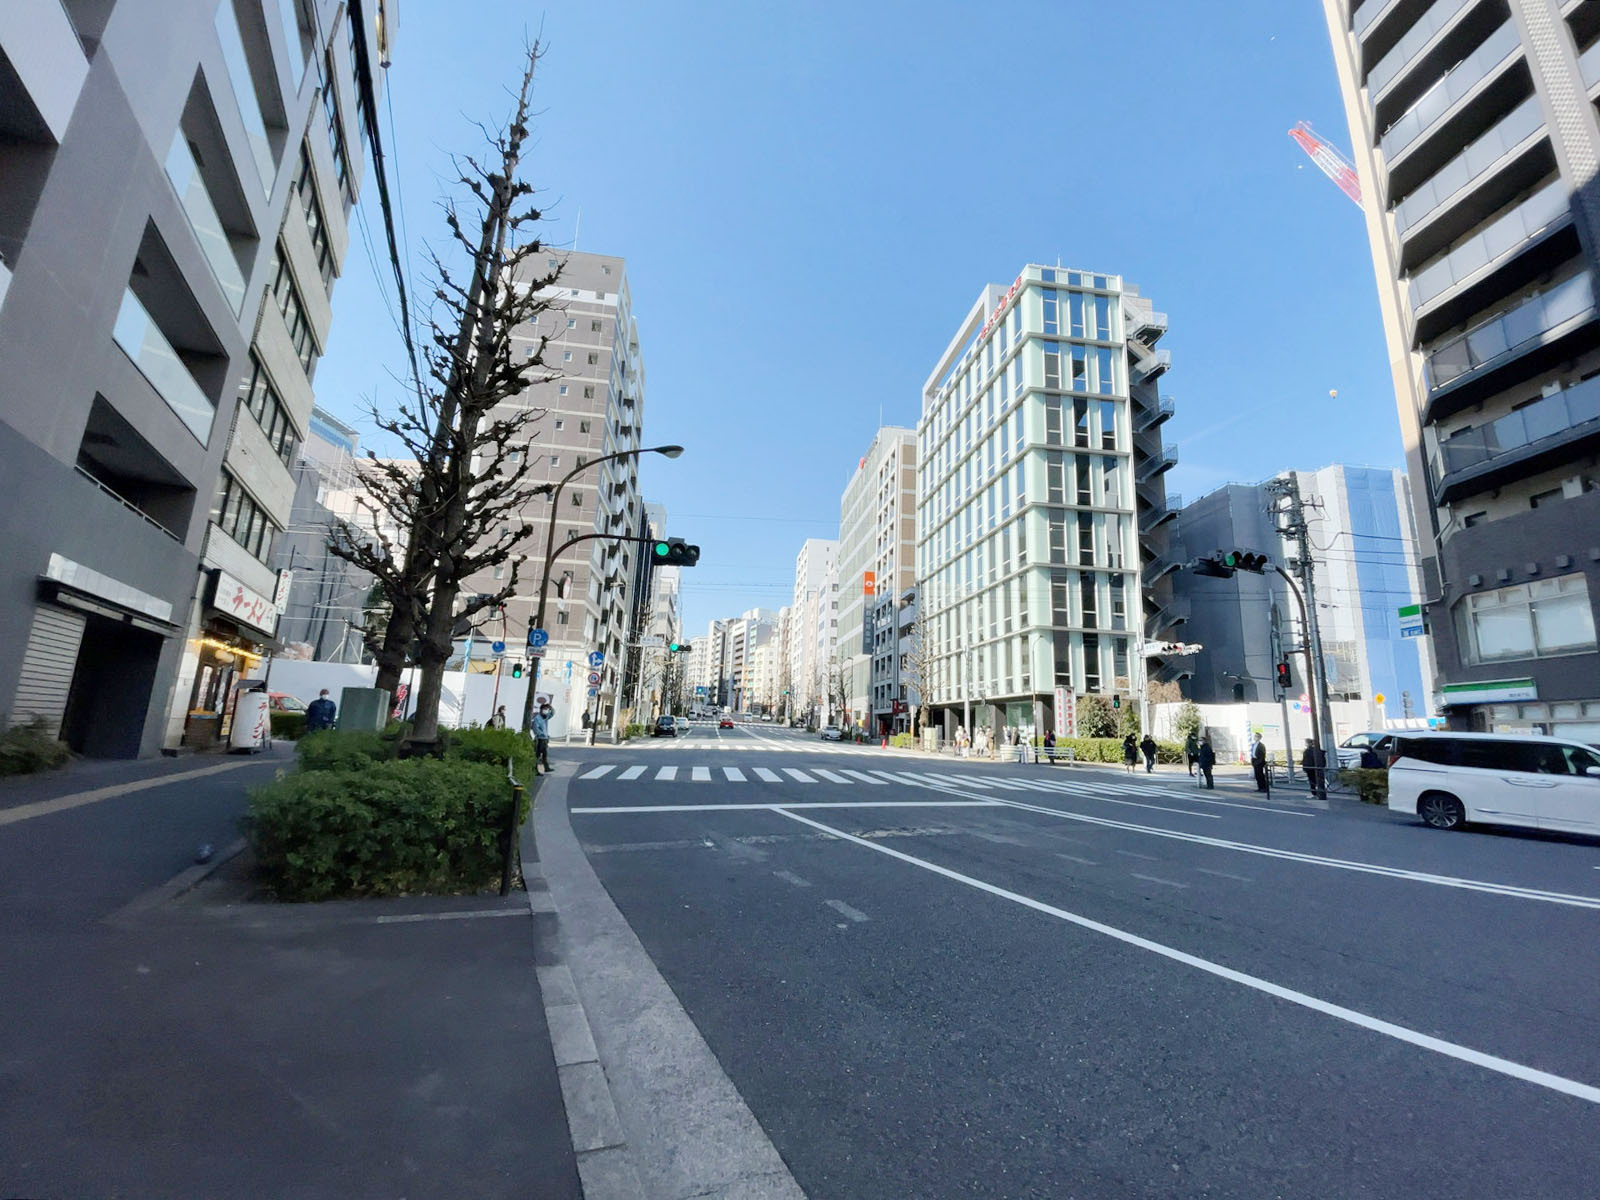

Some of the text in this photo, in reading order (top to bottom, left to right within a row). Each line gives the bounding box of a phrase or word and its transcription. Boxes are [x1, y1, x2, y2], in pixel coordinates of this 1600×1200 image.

[232, 586, 267, 625] ラーメン
[252, 702, 267, 739] ラーメン
